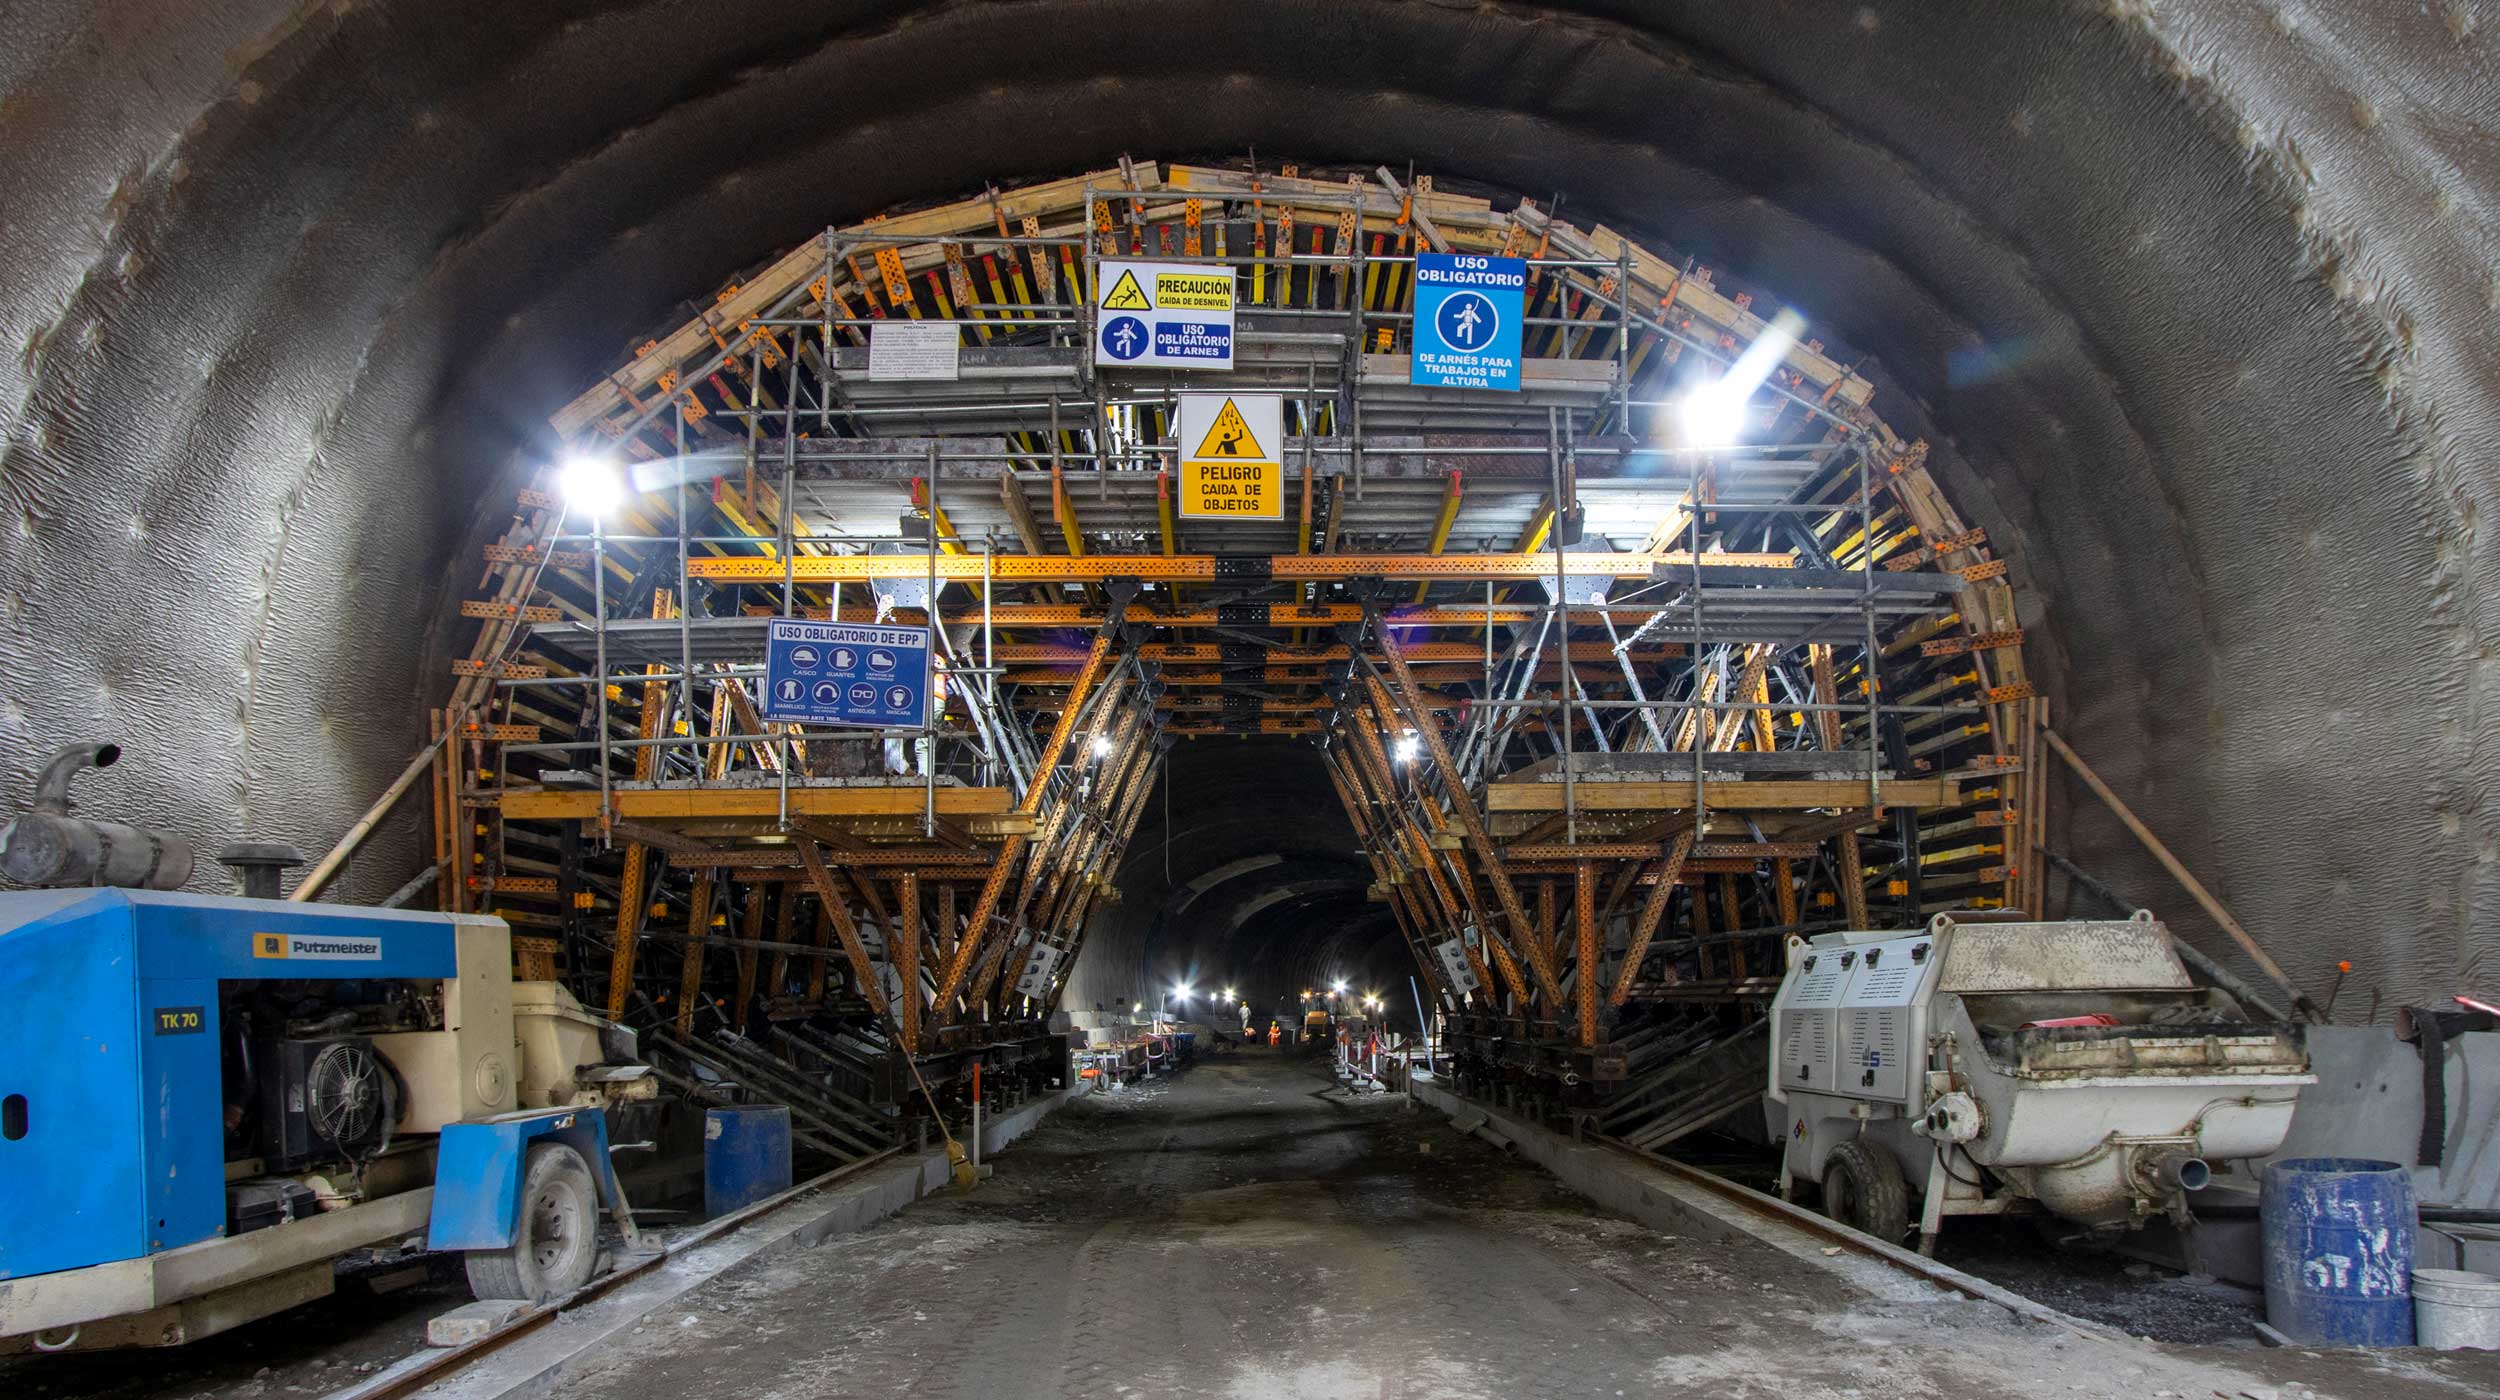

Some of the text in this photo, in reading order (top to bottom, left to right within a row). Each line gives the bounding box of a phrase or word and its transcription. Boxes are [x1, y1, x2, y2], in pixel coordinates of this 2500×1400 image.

[1455, 257, 1488, 270] USO
[1418, 270, 1523, 286] OBLIGATORIO
[1158, 279, 1230, 295] PRECAUCIÓN
[1160, 296, 1180, 305] CAÍDA
[1194, 298, 1229, 306] DESNIVEL
[1182, 325, 1204, 334] USO
[1157, 334, 1229, 346] OBLIGATORIO
[1184, 347, 1219, 356] ARNES
[1420, 353, 1512, 368] DE ARNÉS PARA
[1425, 364, 1506, 377] TRABAJOS EN
[1442, 376, 1488, 387] ALTURA
[1201, 466, 1262, 480] PELIGRO
[1202, 484, 1261, 495] CAIDA DE
[1204, 499, 1259, 510] OBJETOS
[779, 627, 919, 645] USO OBLIGATORIO DE EPP
[293, 941, 377, 954] Putzmeister
[161, 1013, 198, 1028] TK 70
